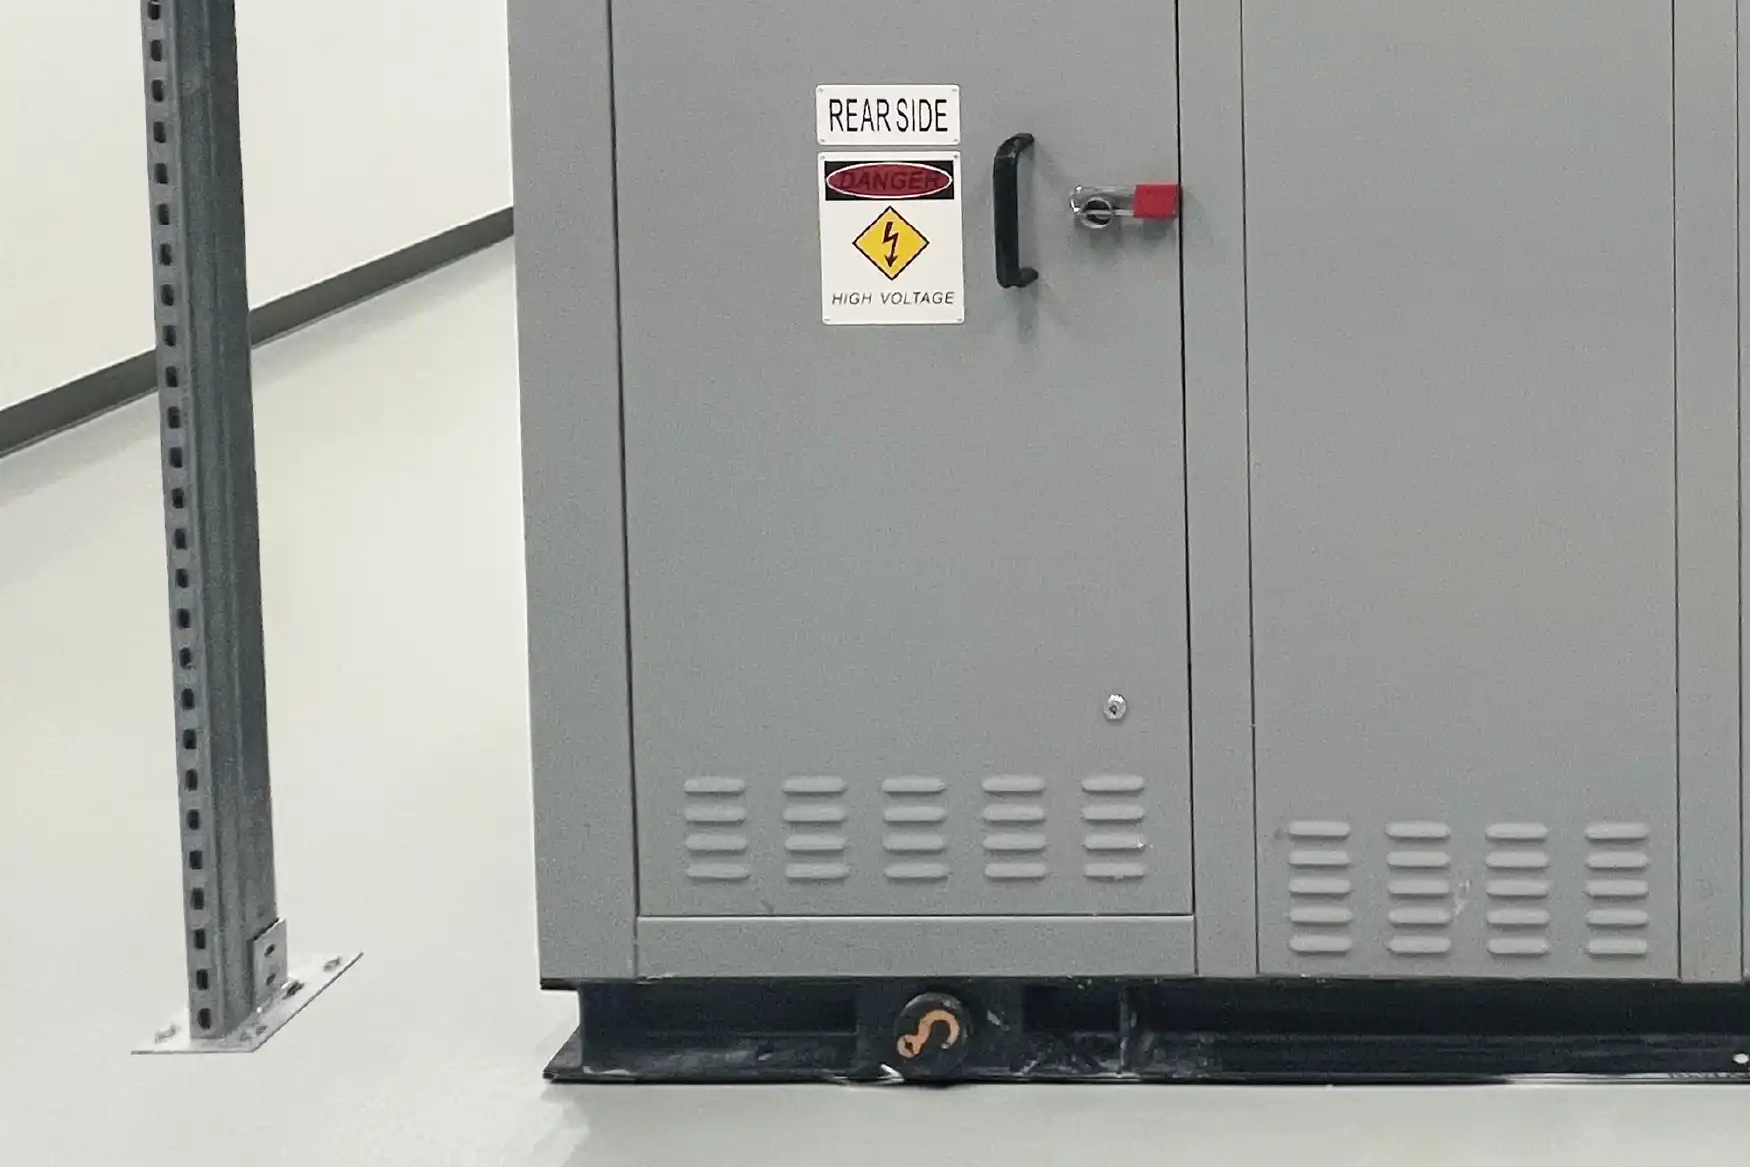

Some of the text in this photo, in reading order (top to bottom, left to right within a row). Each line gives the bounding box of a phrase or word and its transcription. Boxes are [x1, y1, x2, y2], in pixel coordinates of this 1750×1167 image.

[828, 97, 948, 133] REAR SIDE
[838, 168, 940, 190] DANGER
[831, 291, 955, 306] HIGH VOLTAGE
